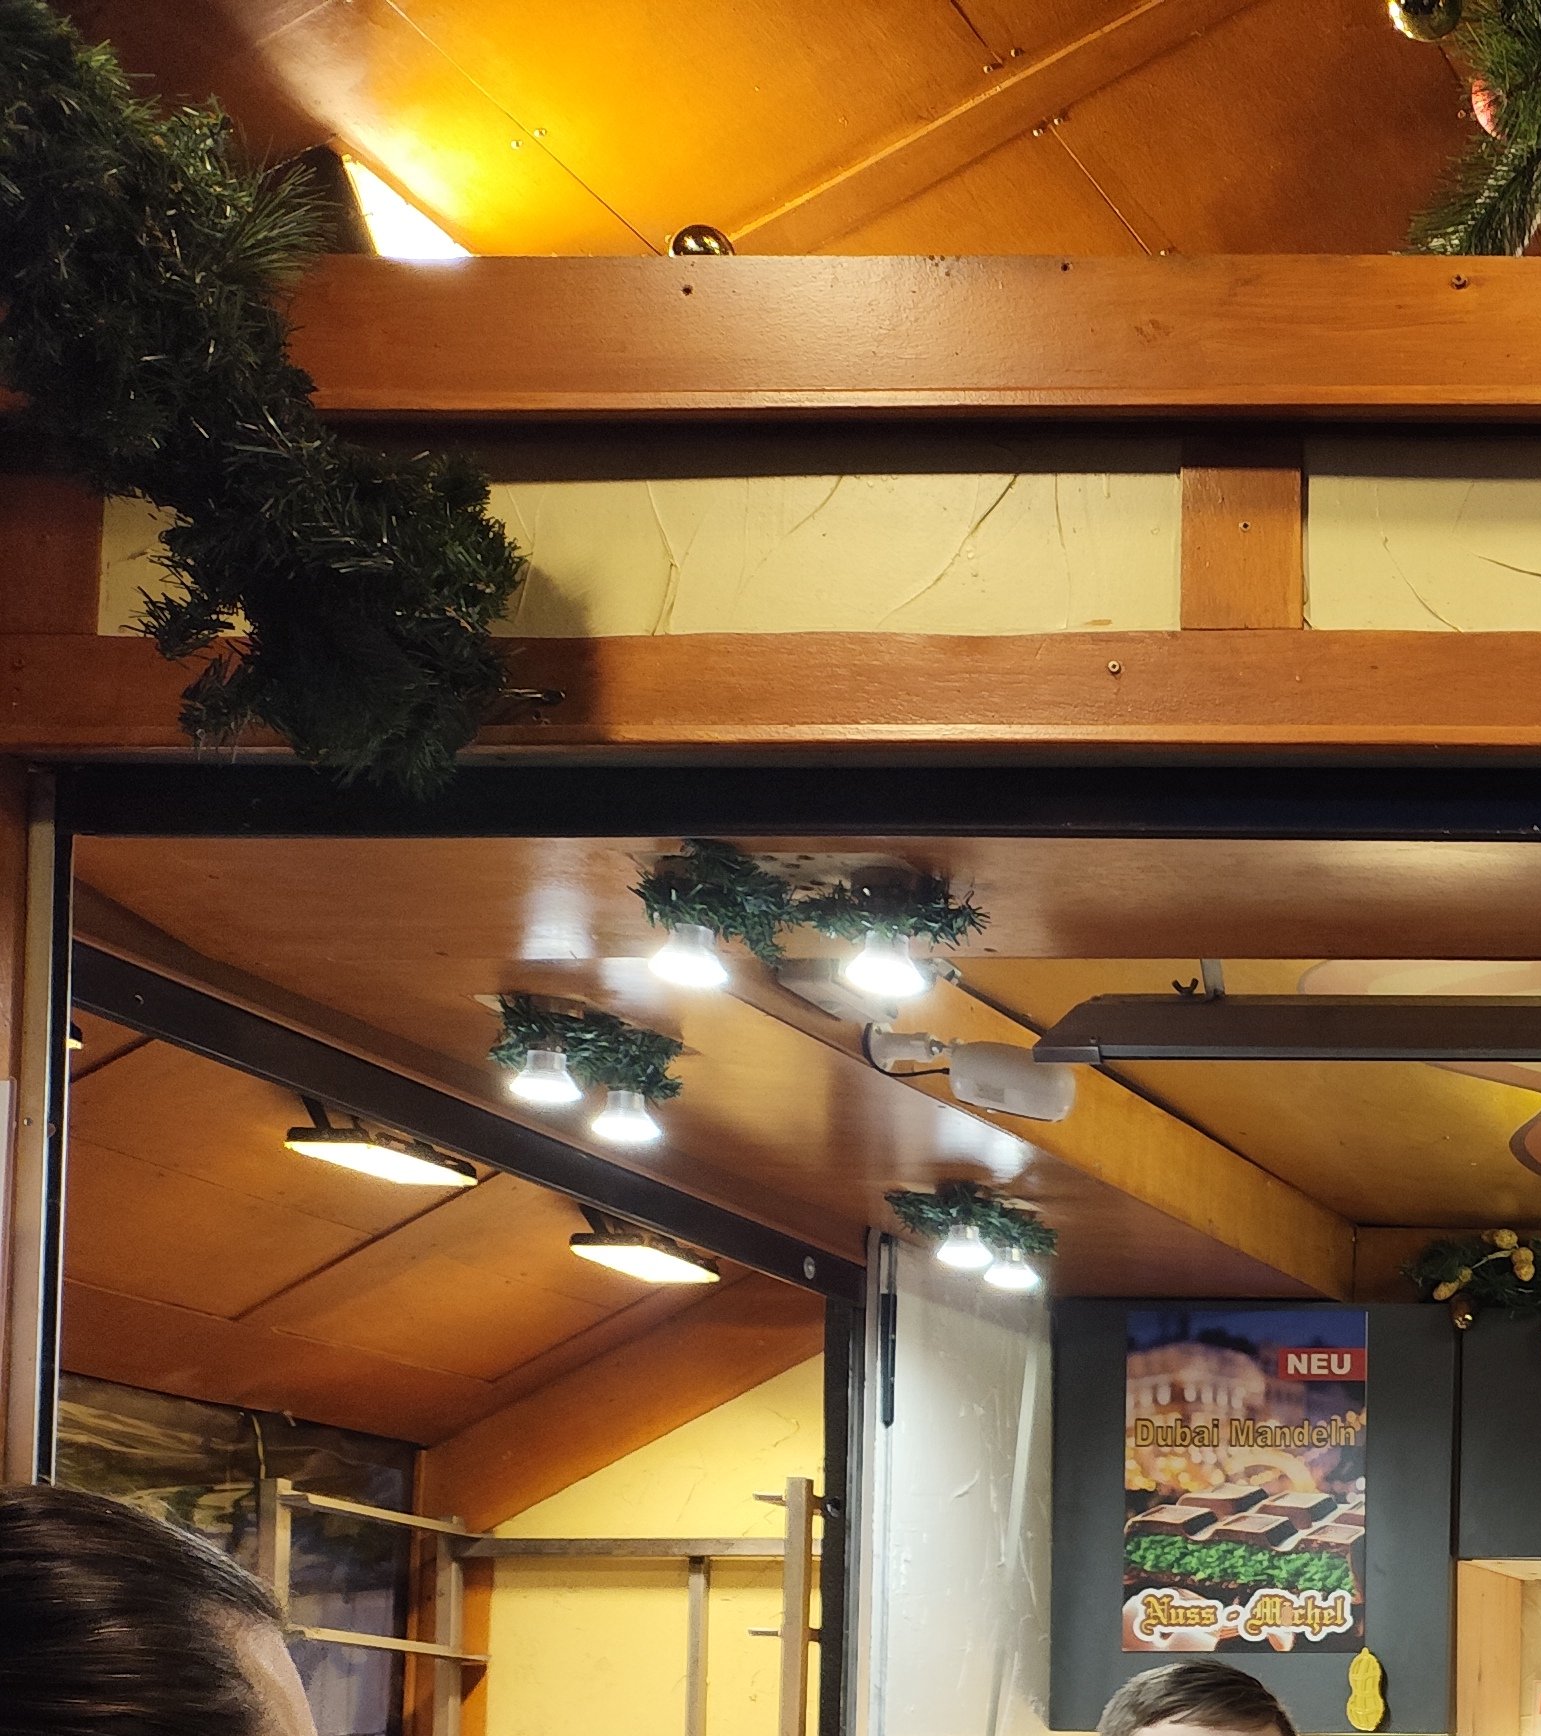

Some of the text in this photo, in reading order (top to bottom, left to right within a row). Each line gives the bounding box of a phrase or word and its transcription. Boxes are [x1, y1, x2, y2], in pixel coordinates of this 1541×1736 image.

[1287, 1354, 1351, 1374] NEU
[1135, 1419, 1356, 1447] Dubai Mandeln
[1143, 1594, 1216, 1635] Nuss
